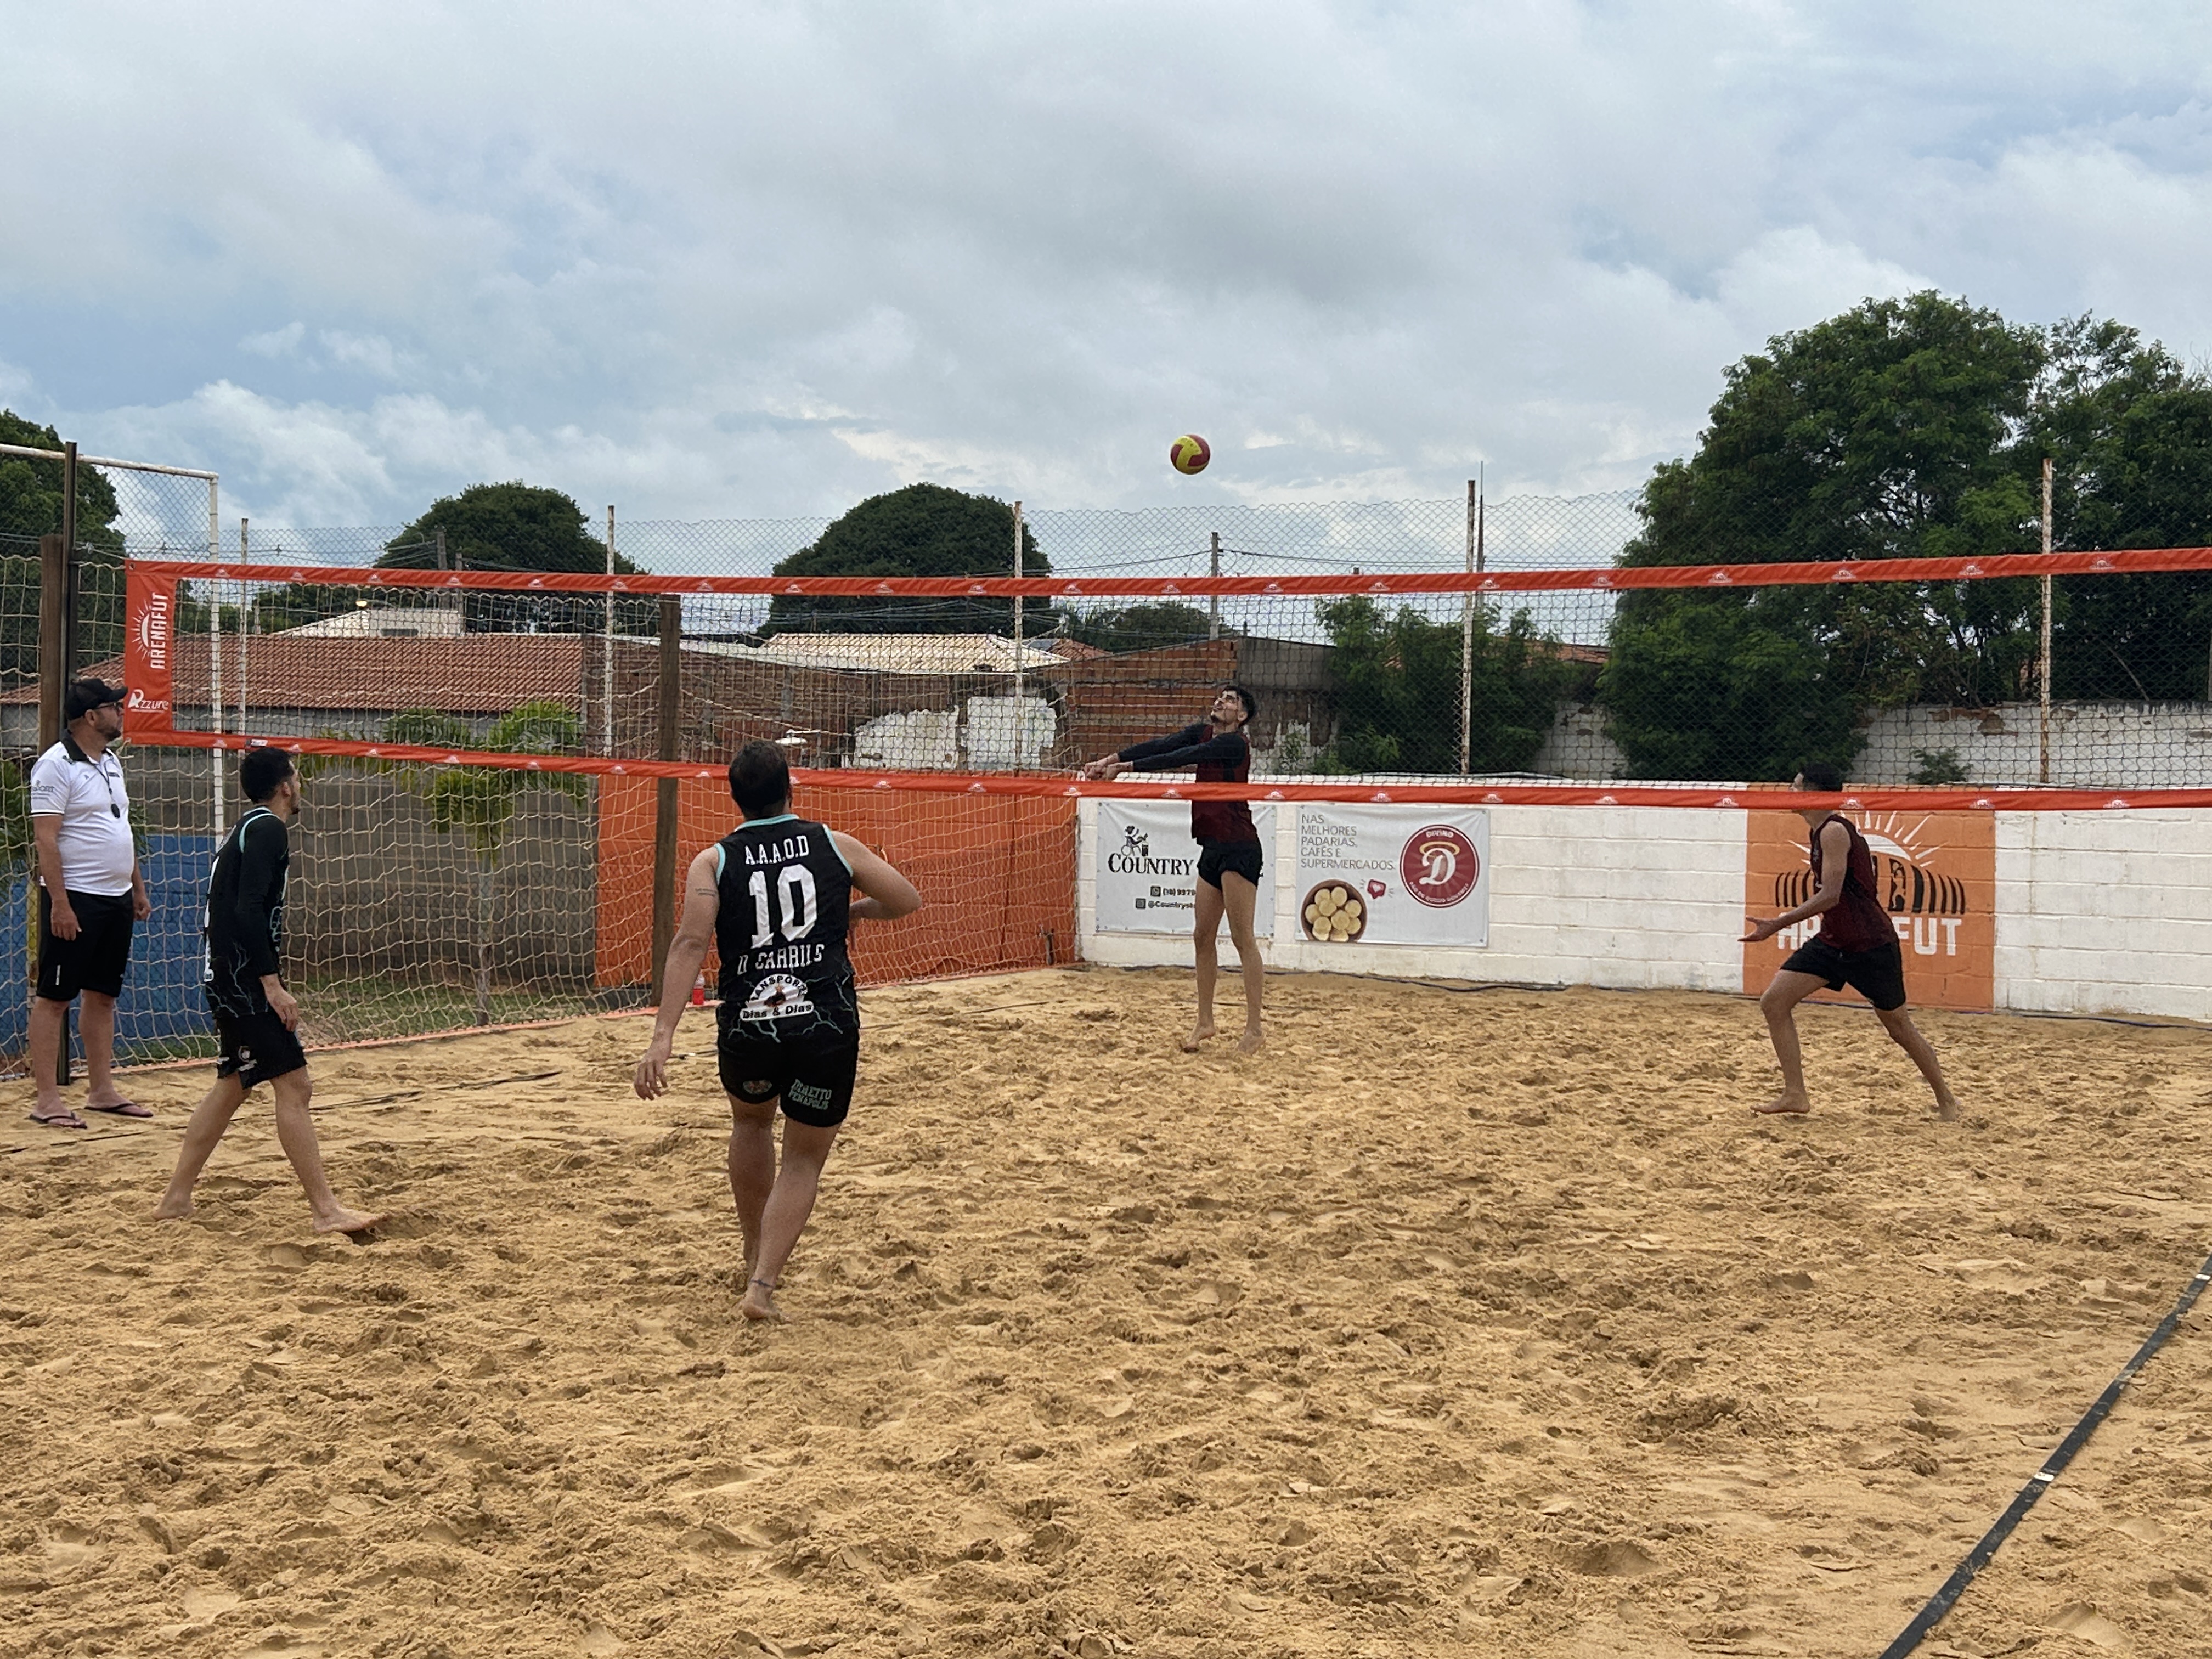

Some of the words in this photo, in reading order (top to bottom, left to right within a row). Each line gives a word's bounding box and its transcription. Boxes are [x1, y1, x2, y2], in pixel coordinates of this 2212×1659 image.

[150, 591, 168, 669] ARENAFUT
[1302, 814, 1324, 823] NAS
[1301, 826, 1357, 836] MELHORES
[1301, 837, 1358, 847] PADARIAS,
[1301, 846, 1333, 857] CAFÉS
[1335, 848, 1341, 857] E
[1108, 853, 1194, 876] COUNTRY
[1301, 859, 1395, 870] SUPERMERCADOS.
[748, 863, 817, 949] 10
